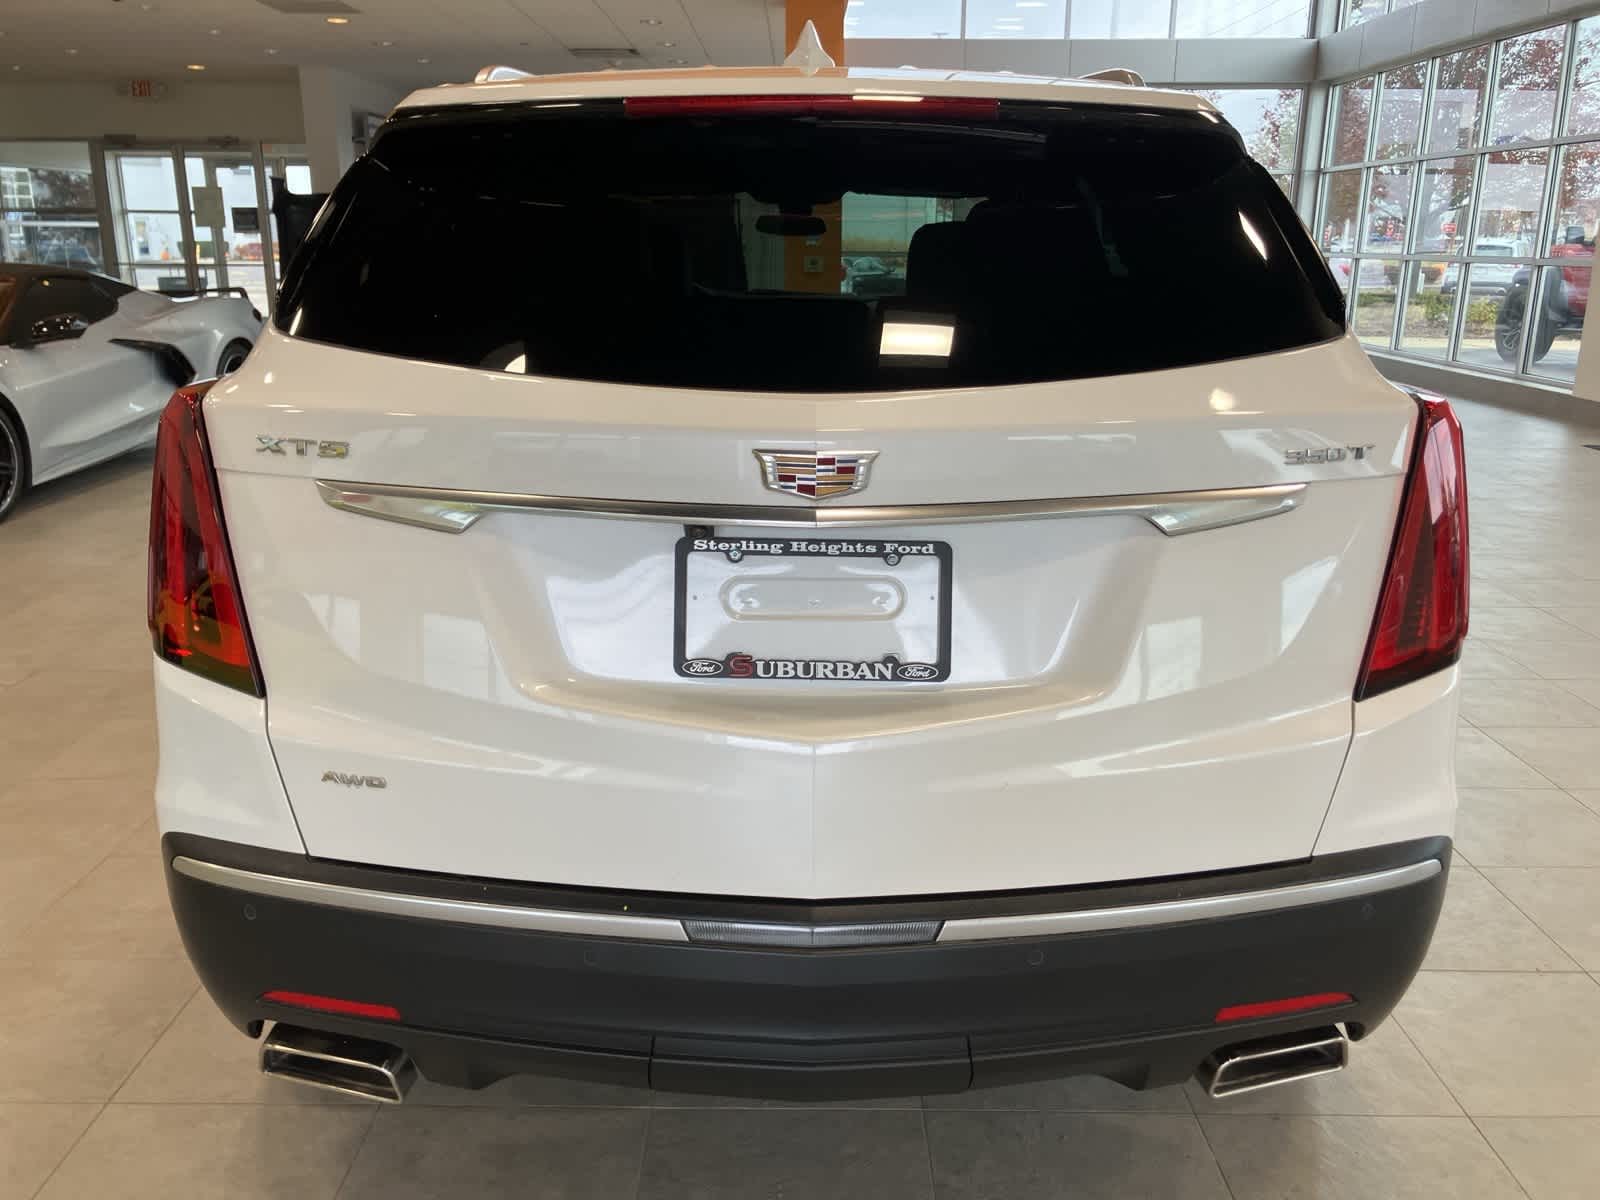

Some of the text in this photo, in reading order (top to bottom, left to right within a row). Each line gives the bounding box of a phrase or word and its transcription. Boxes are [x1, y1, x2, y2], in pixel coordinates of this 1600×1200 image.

[131, 80, 152, 97] EXIT
[256, 435, 349, 459] XT5
[693, 539, 935, 555] Sterling Heights Ford
[688, 660, 718, 674] Ford
[729, 655, 893, 679] SUBURBAN
[902, 665, 933, 678] Ford
[321, 770, 387, 788] AWD
